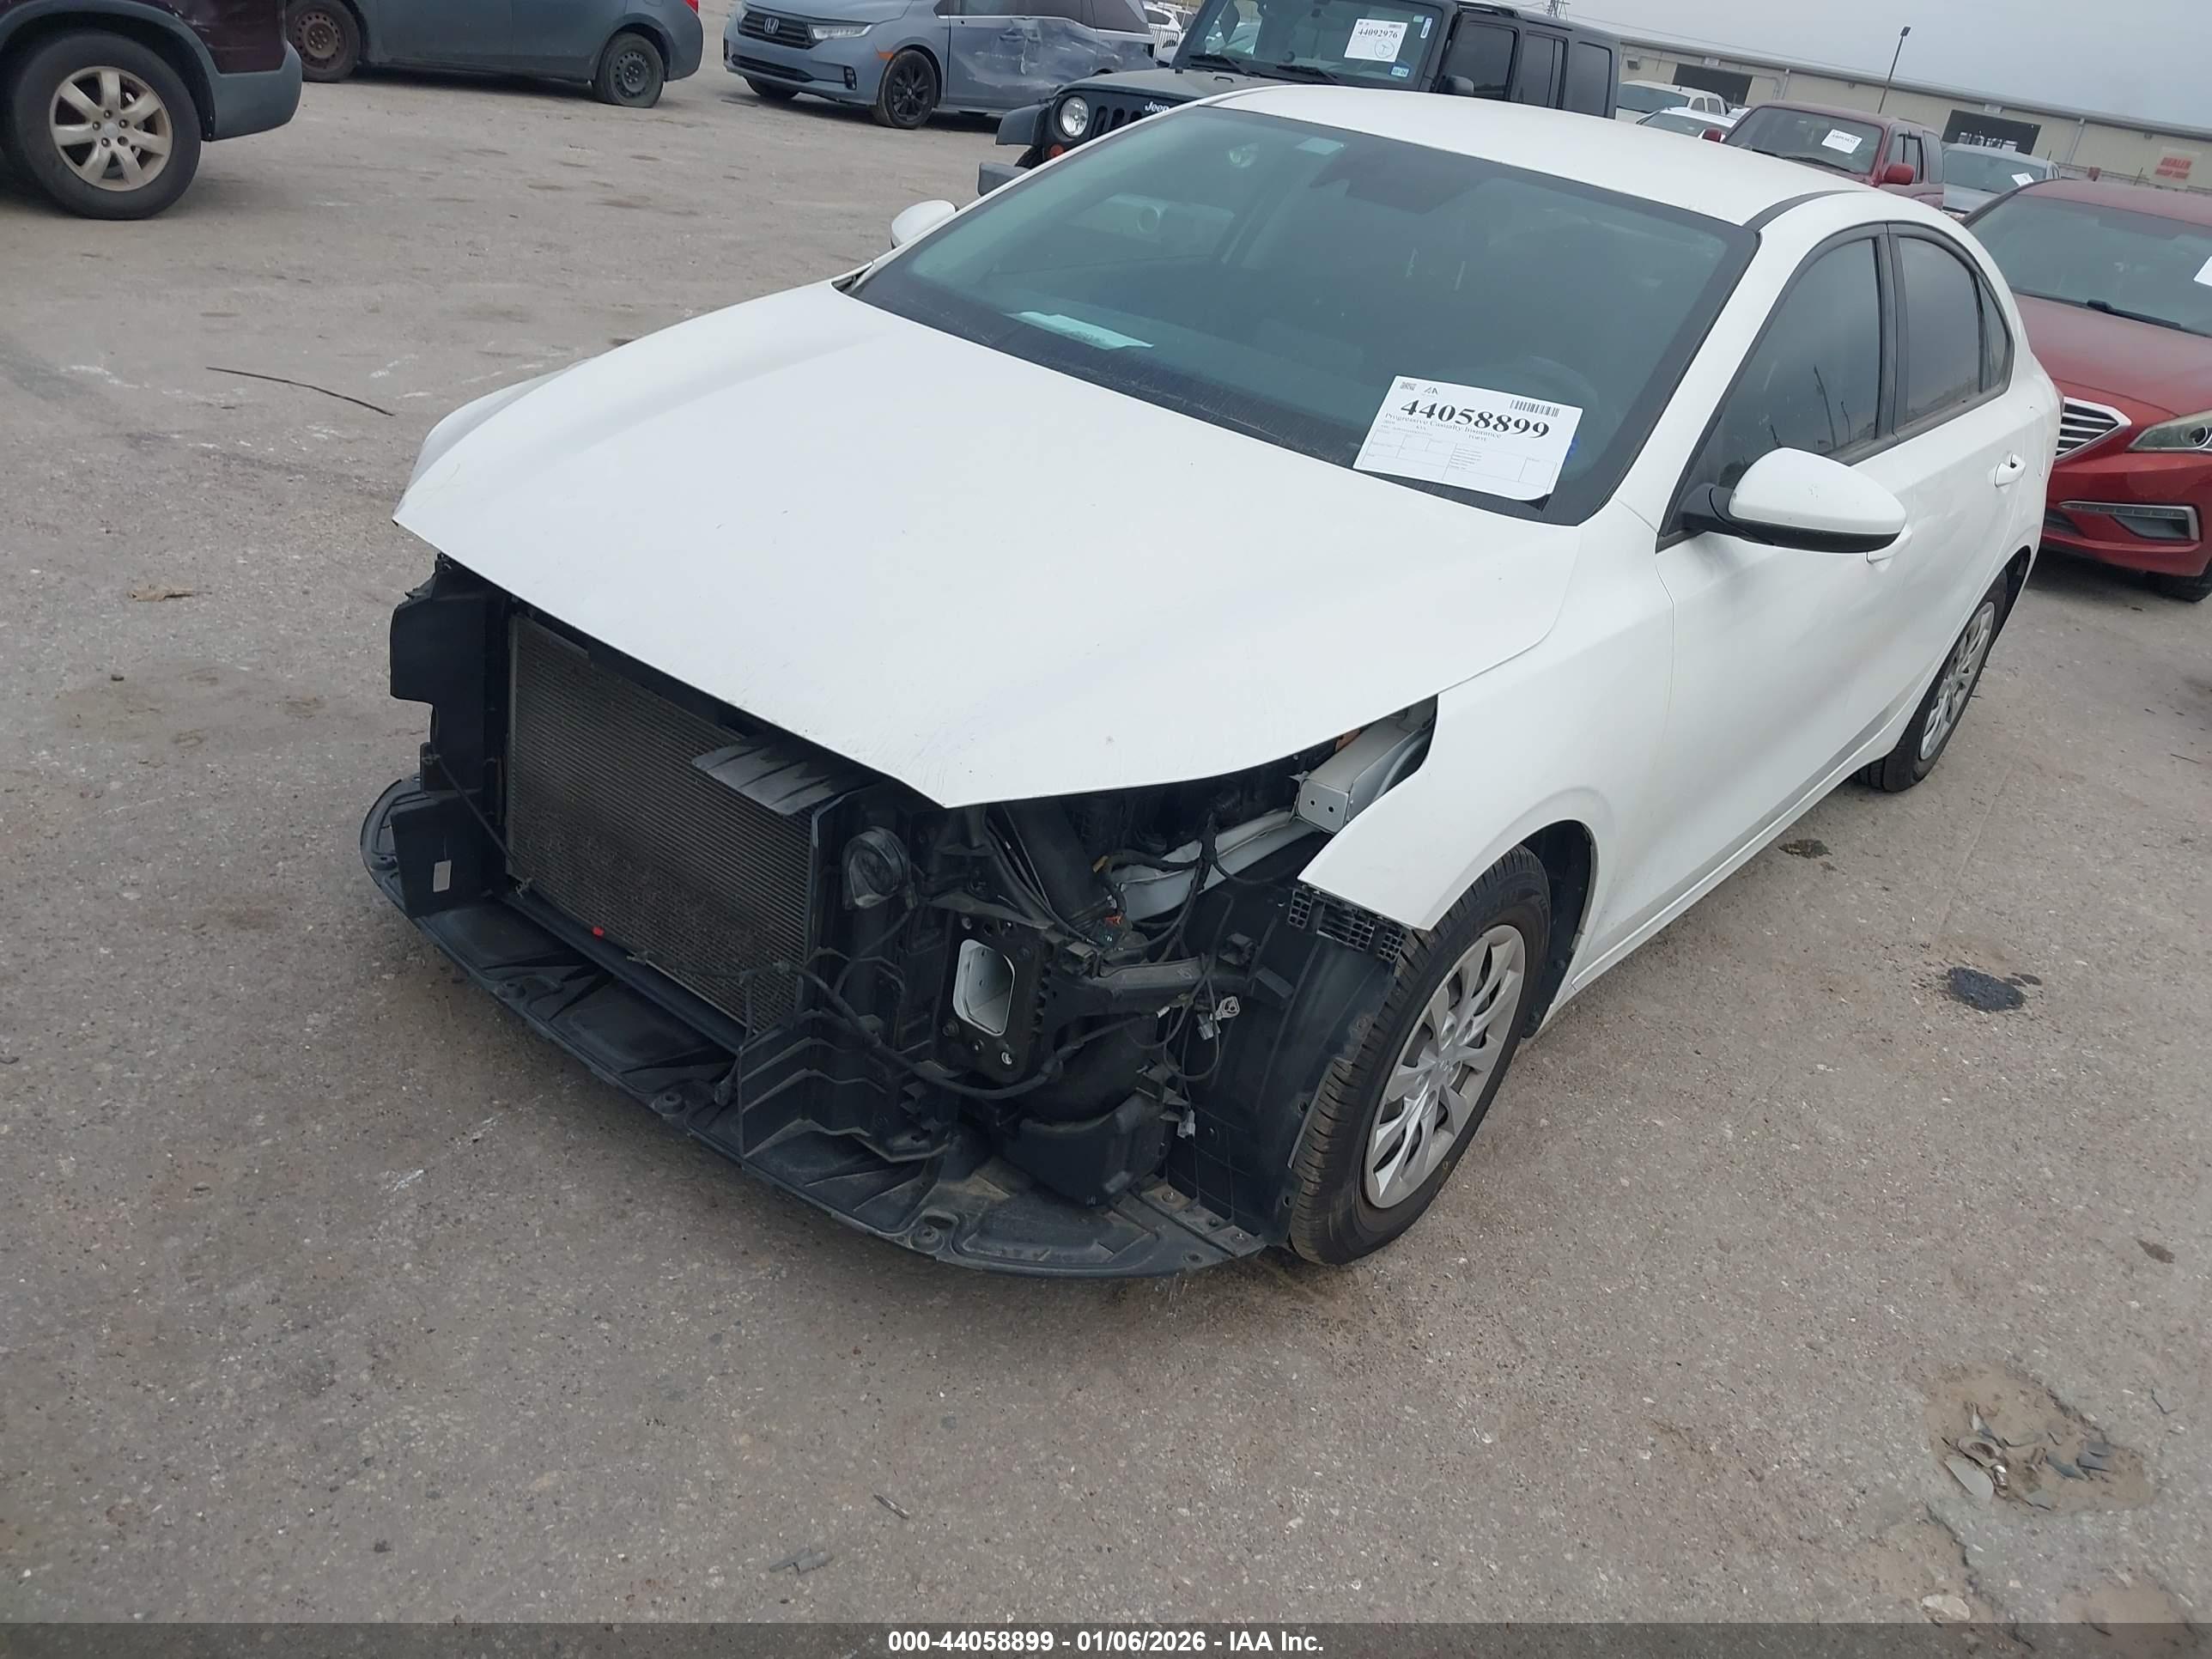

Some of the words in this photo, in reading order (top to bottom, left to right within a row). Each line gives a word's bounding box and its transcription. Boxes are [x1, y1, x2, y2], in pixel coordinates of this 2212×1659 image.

[1358, 27, 1398, 39] 44092976
[1385, 413, 1428, 427] Progressive
[1430, 421, 1463, 431] Casualty
[1465, 426, 1502, 439] Insurance
[1401, 399, 1550, 439] 44058899
